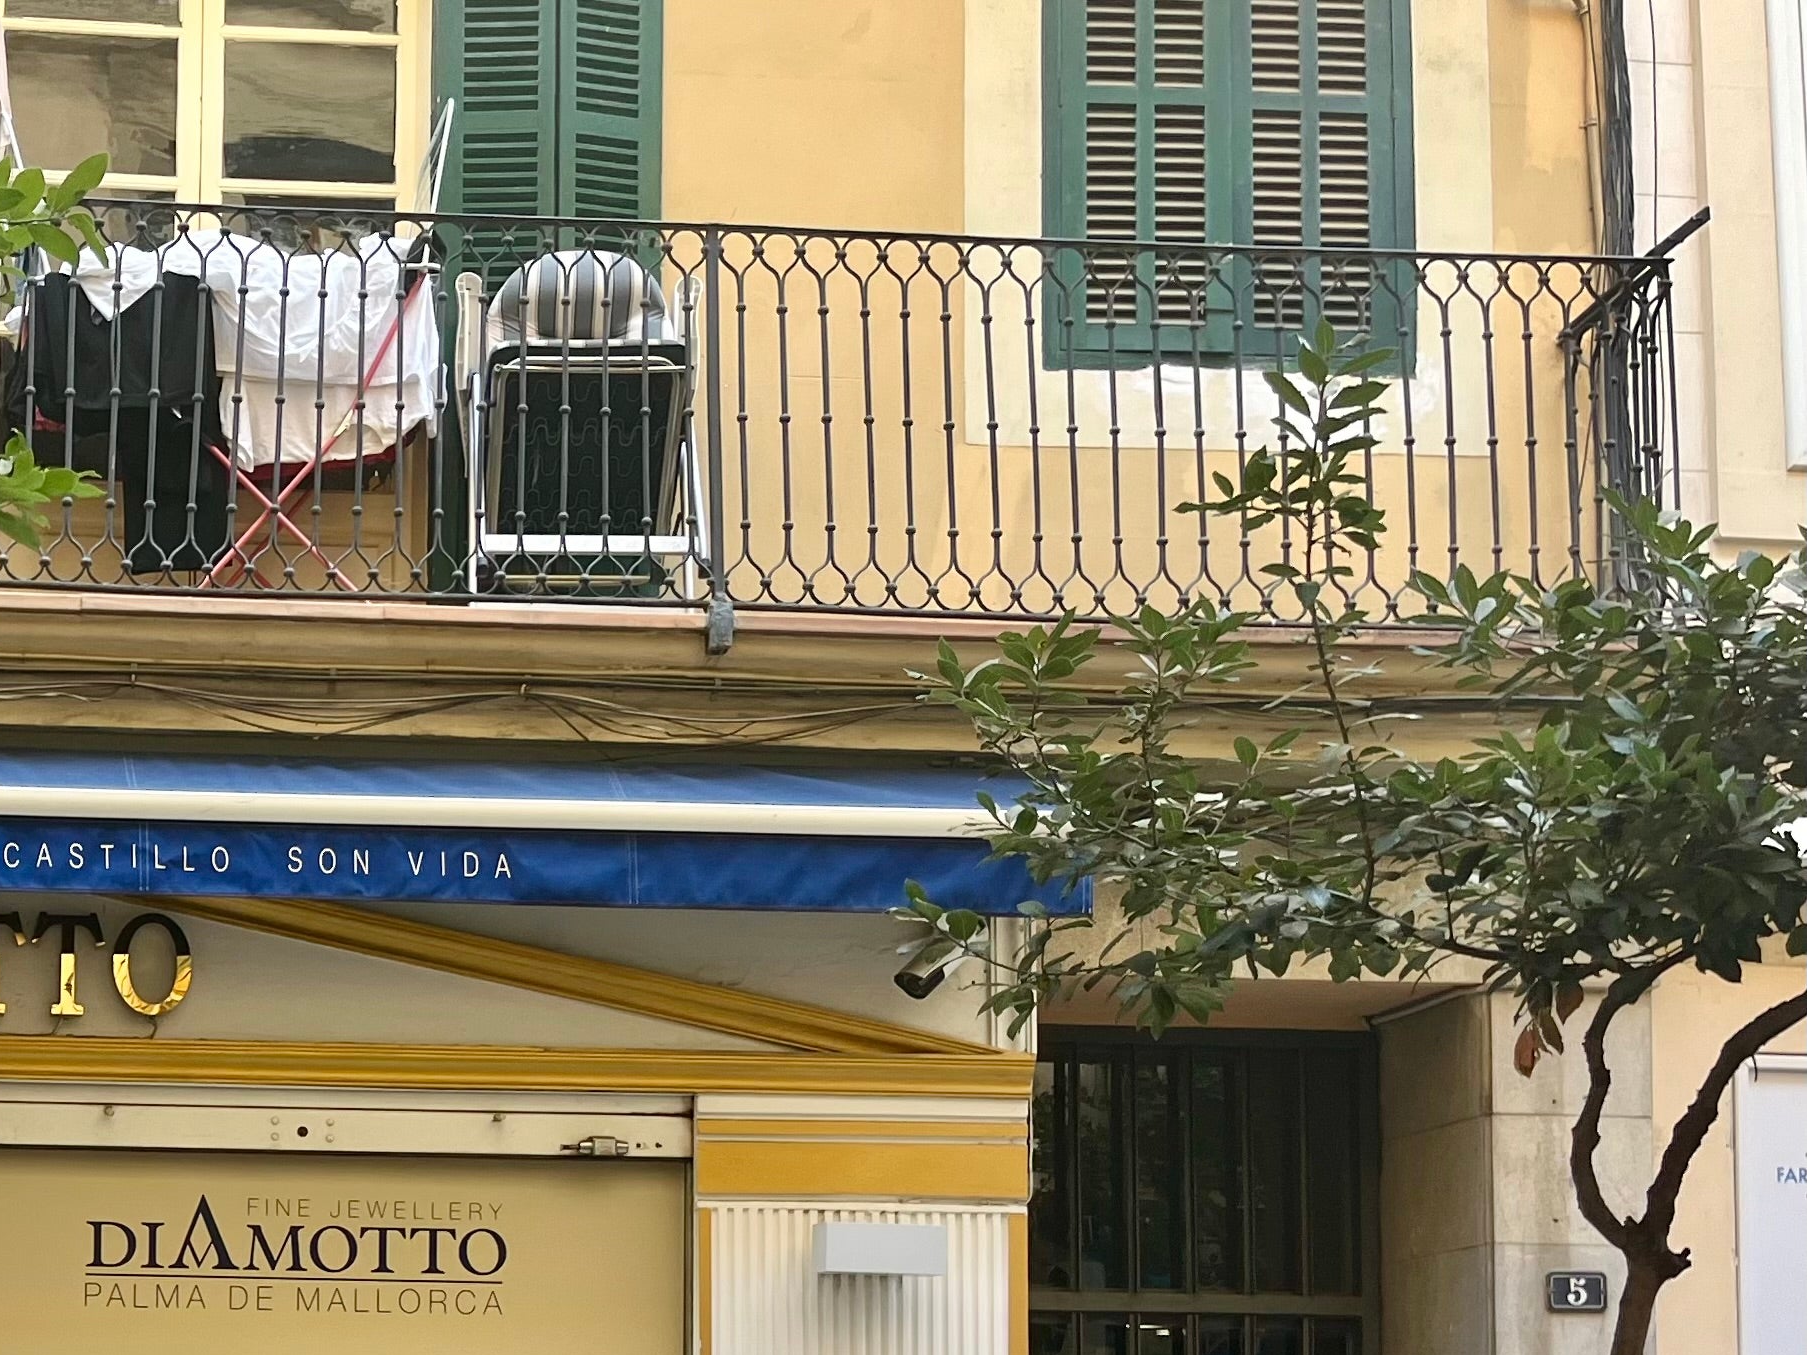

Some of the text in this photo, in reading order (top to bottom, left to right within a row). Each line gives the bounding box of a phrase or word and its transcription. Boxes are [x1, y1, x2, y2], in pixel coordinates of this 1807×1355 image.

[3, 842, 230, 873] CASTILLO
[288, 846, 371, 876] SON
[407, 850, 512, 881] VIDA
[246, 1197, 504, 1221] FINE JEWELLERY
[86, 1194, 508, 1277] DIAMOTTO
[84, 1282, 504, 1316] PALMA DE MALLORCA
[1567, 1278, 1587, 1306] 5
